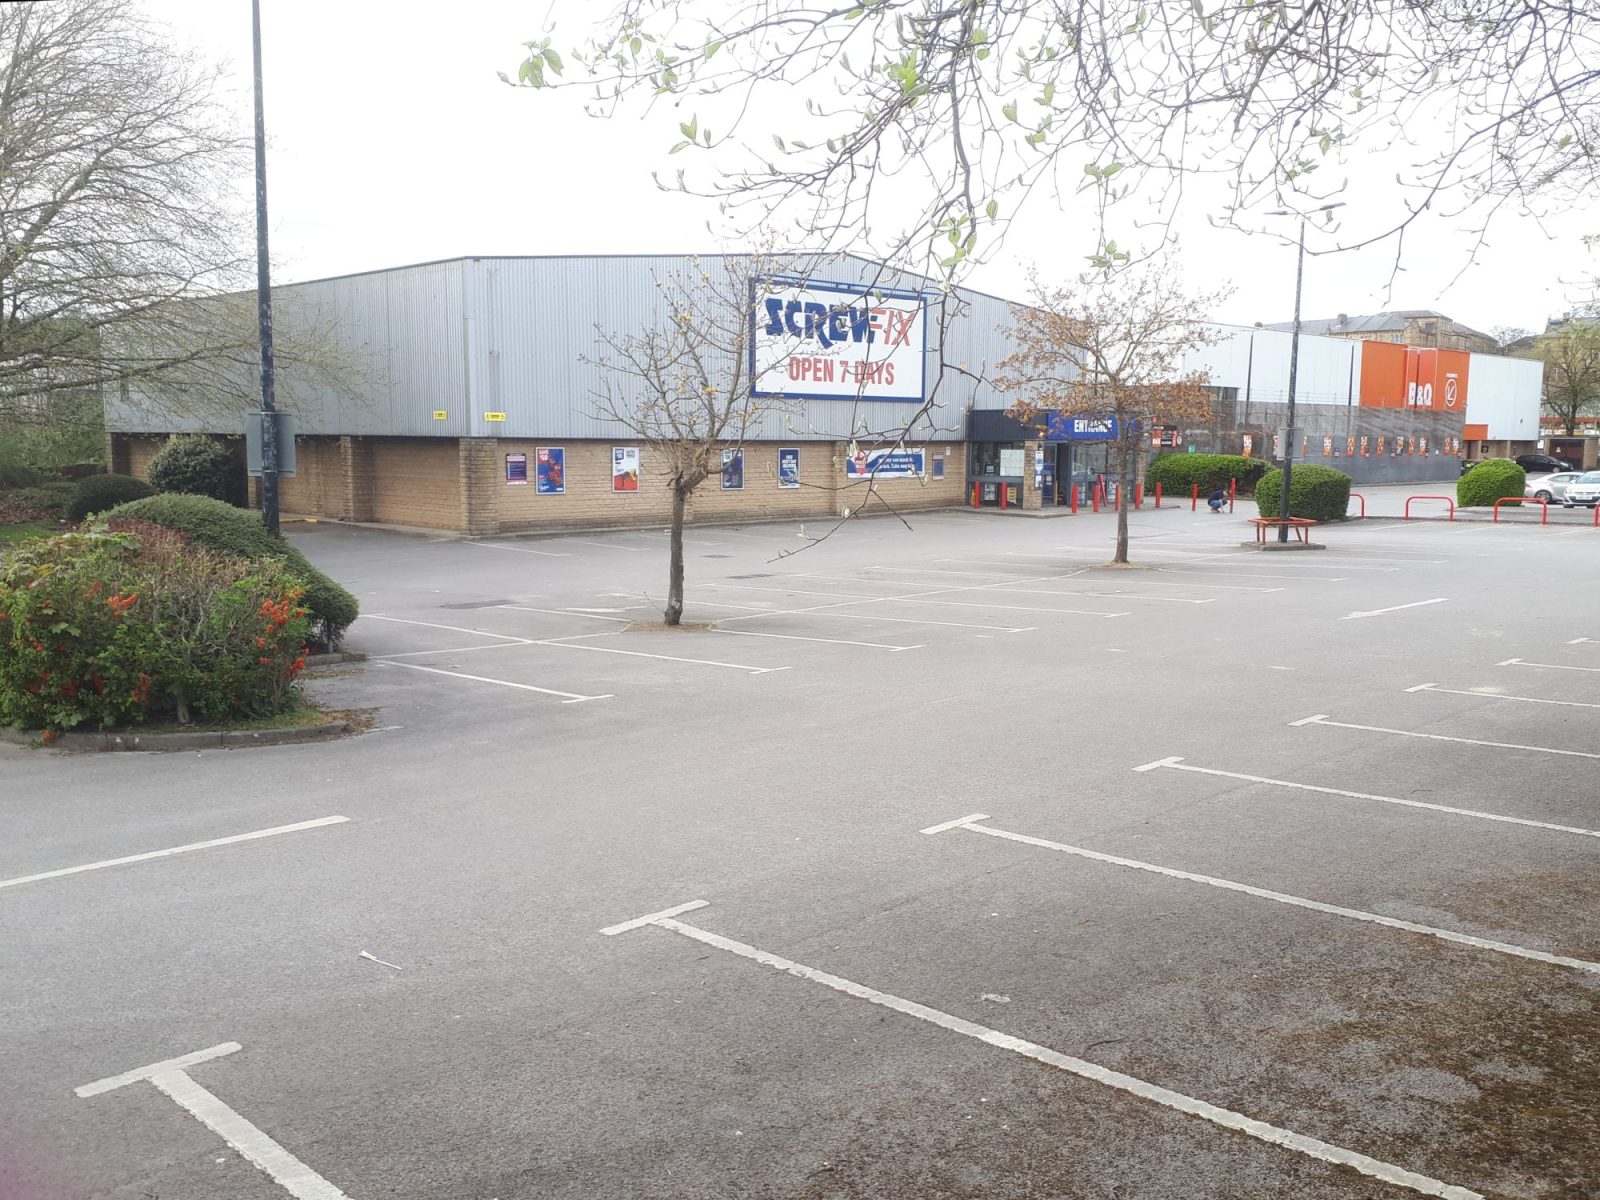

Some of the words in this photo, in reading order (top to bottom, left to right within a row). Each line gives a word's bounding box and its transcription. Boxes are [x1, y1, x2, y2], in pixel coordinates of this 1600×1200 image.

[765, 298, 917, 349] SCREWFIX
[789, 356, 834, 382] OPEN
[840, 361, 850, 383] 7
[855, 361, 895, 385] DAYS
[1408, 382, 1432, 406] B&Q
